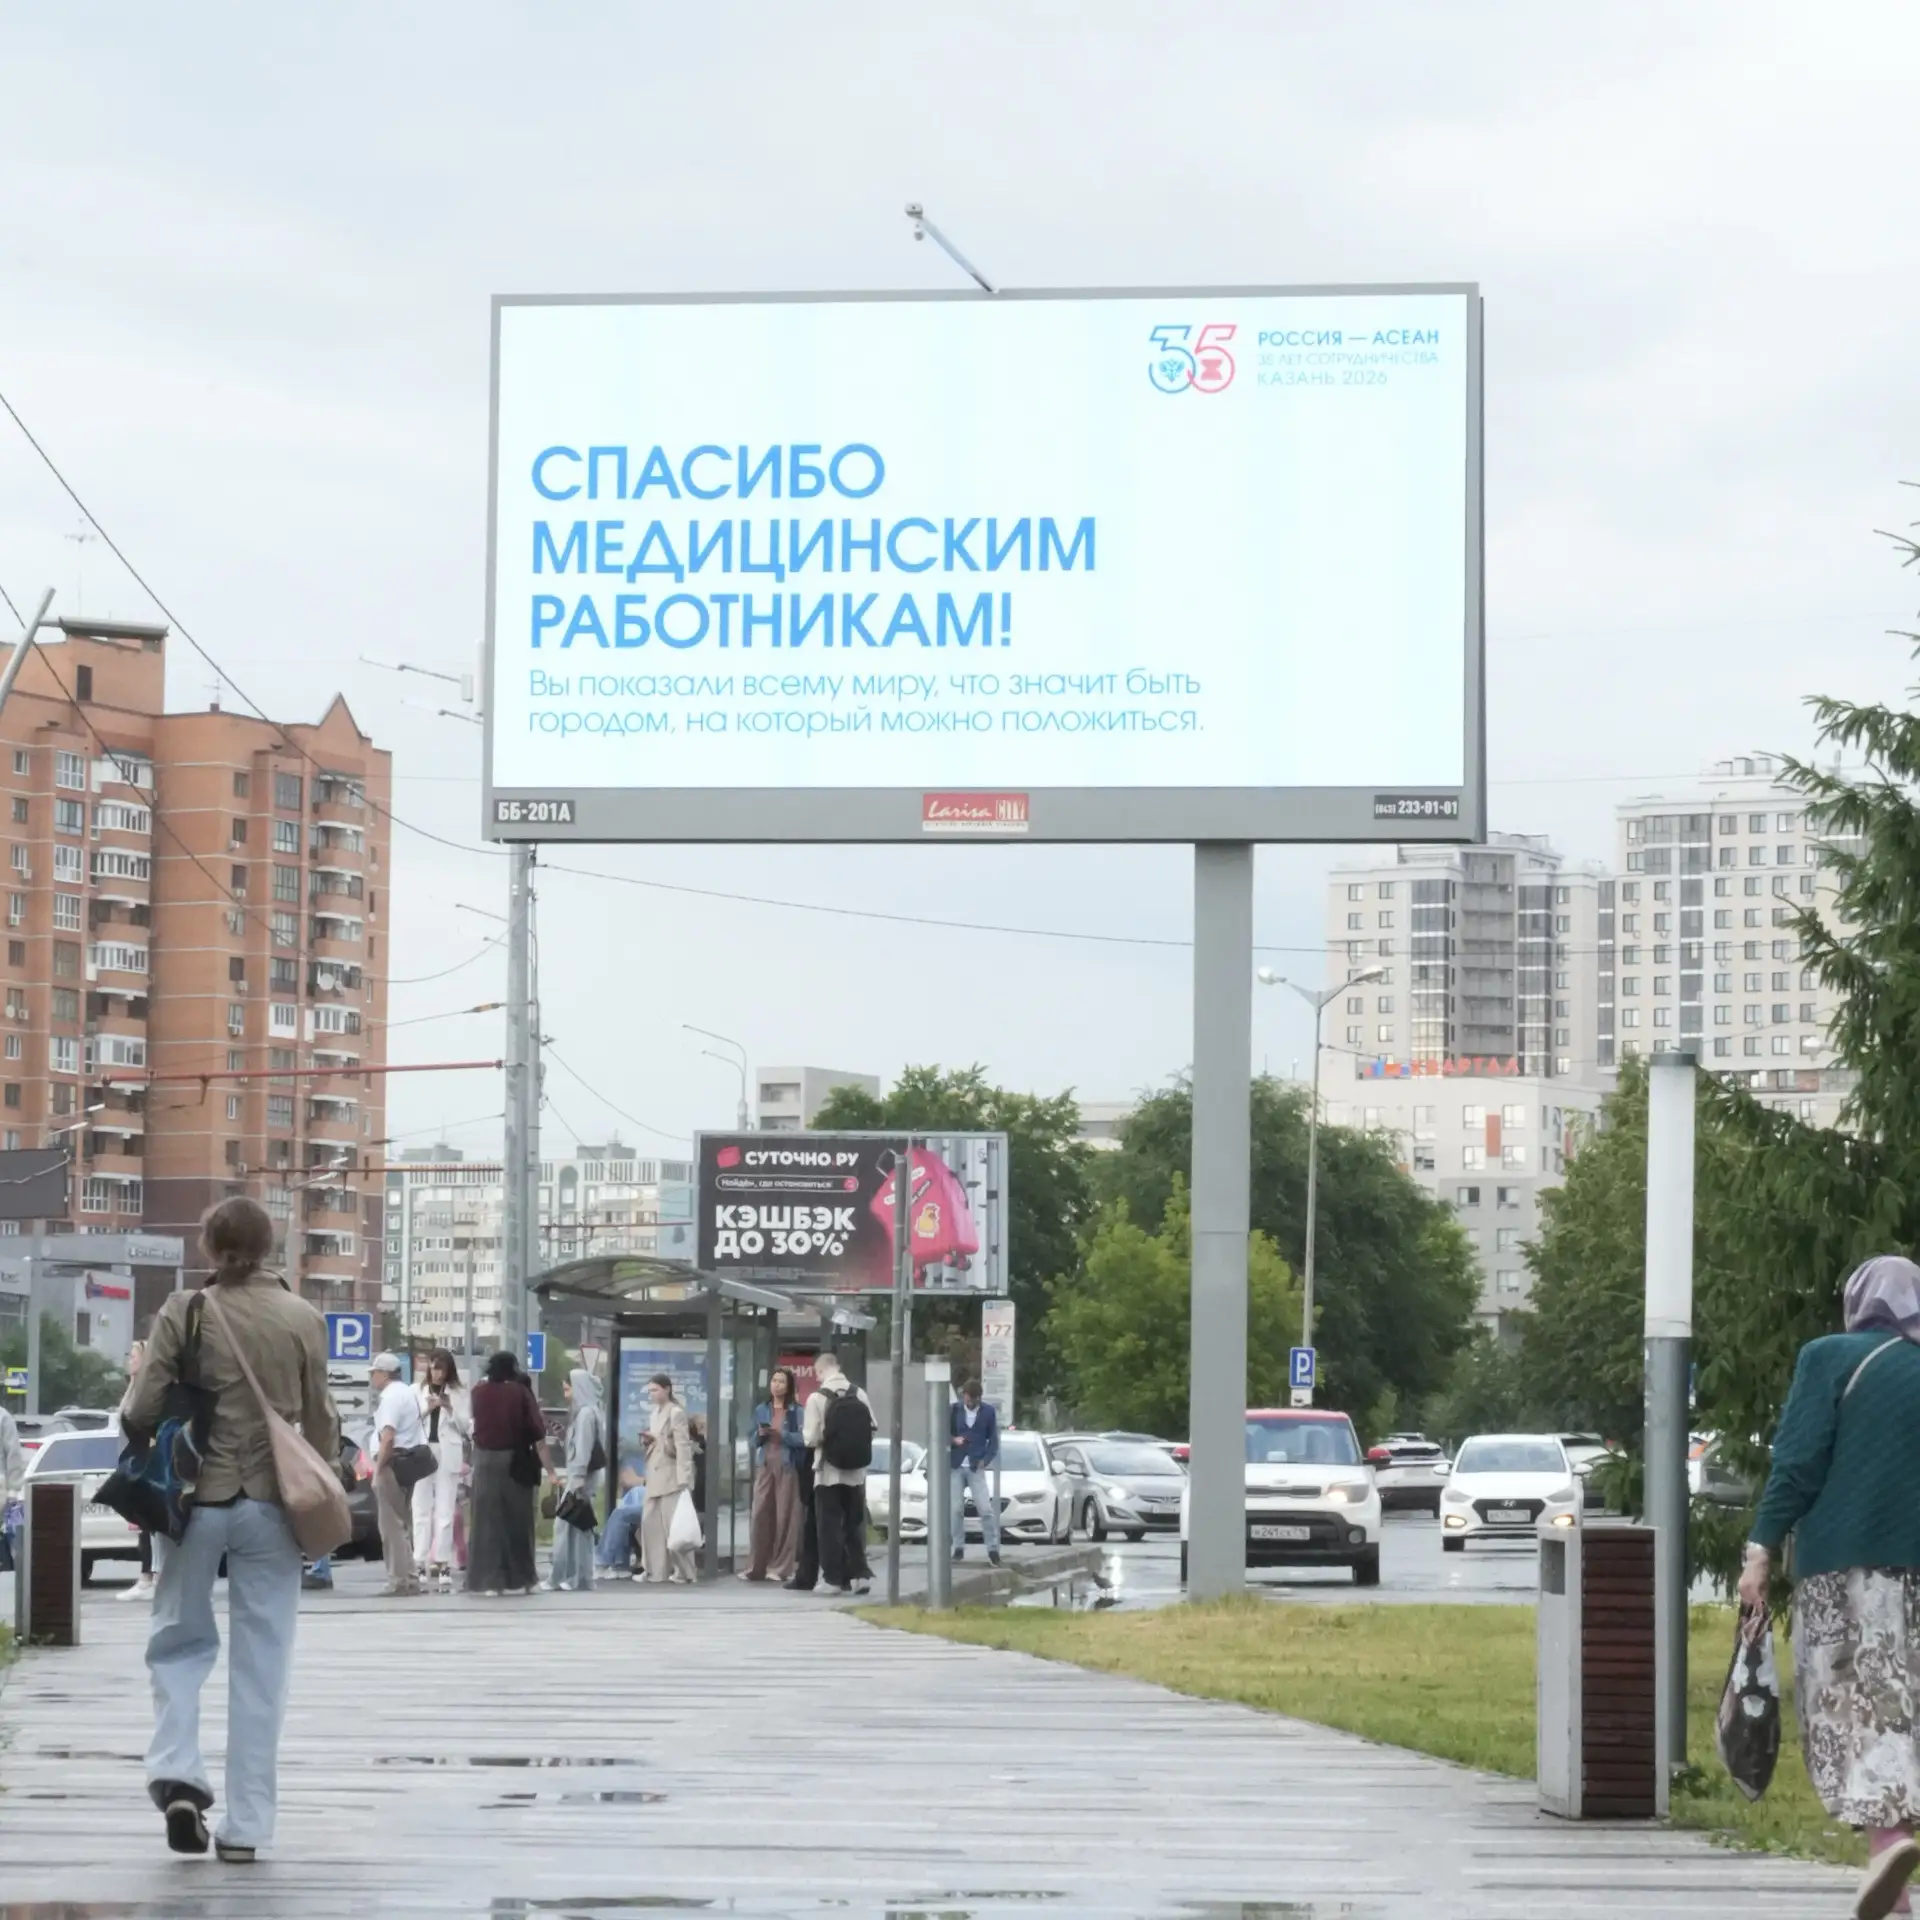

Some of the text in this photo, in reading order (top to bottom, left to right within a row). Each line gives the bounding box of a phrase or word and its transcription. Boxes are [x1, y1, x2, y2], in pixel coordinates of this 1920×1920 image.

[1258, 330, 1343, 347] РОССИЯ
[1372, 329, 1440, 345] АСЕАН
[1278, 352, 1302, 366] ЛЕТ
[1257, 369, 1388, 386] КАЗАНЬ 2026
[531, 443, 886, 501] СПАСИБО
[531, 516, 1096, 584] МЕДИЦИНСКИМ
[530, 591, 1012, 649] РАБОТНИКАМ!
[529, 667, 1202, 702] Вы показали всему миру, что значит быть
[529, 703, 1204, 739] городом, на который можно положиться.
[498, 802, 571, 822] ББ-201А
[928, 801, 992, 818] Larisa
[1397, 800, 1458, 815] 233-01-01
[745, 1151, 860, 1167] СУТОЧНО.РУ
[715, 1204, 857, 1231] КЭШБЭК
[714, 1230, 765, 1259] ДО
[336, 1318, 363, 1357] P
[984, 1323, 1013, 1337] 177
[1296, 1352, 1310, 1383] P
